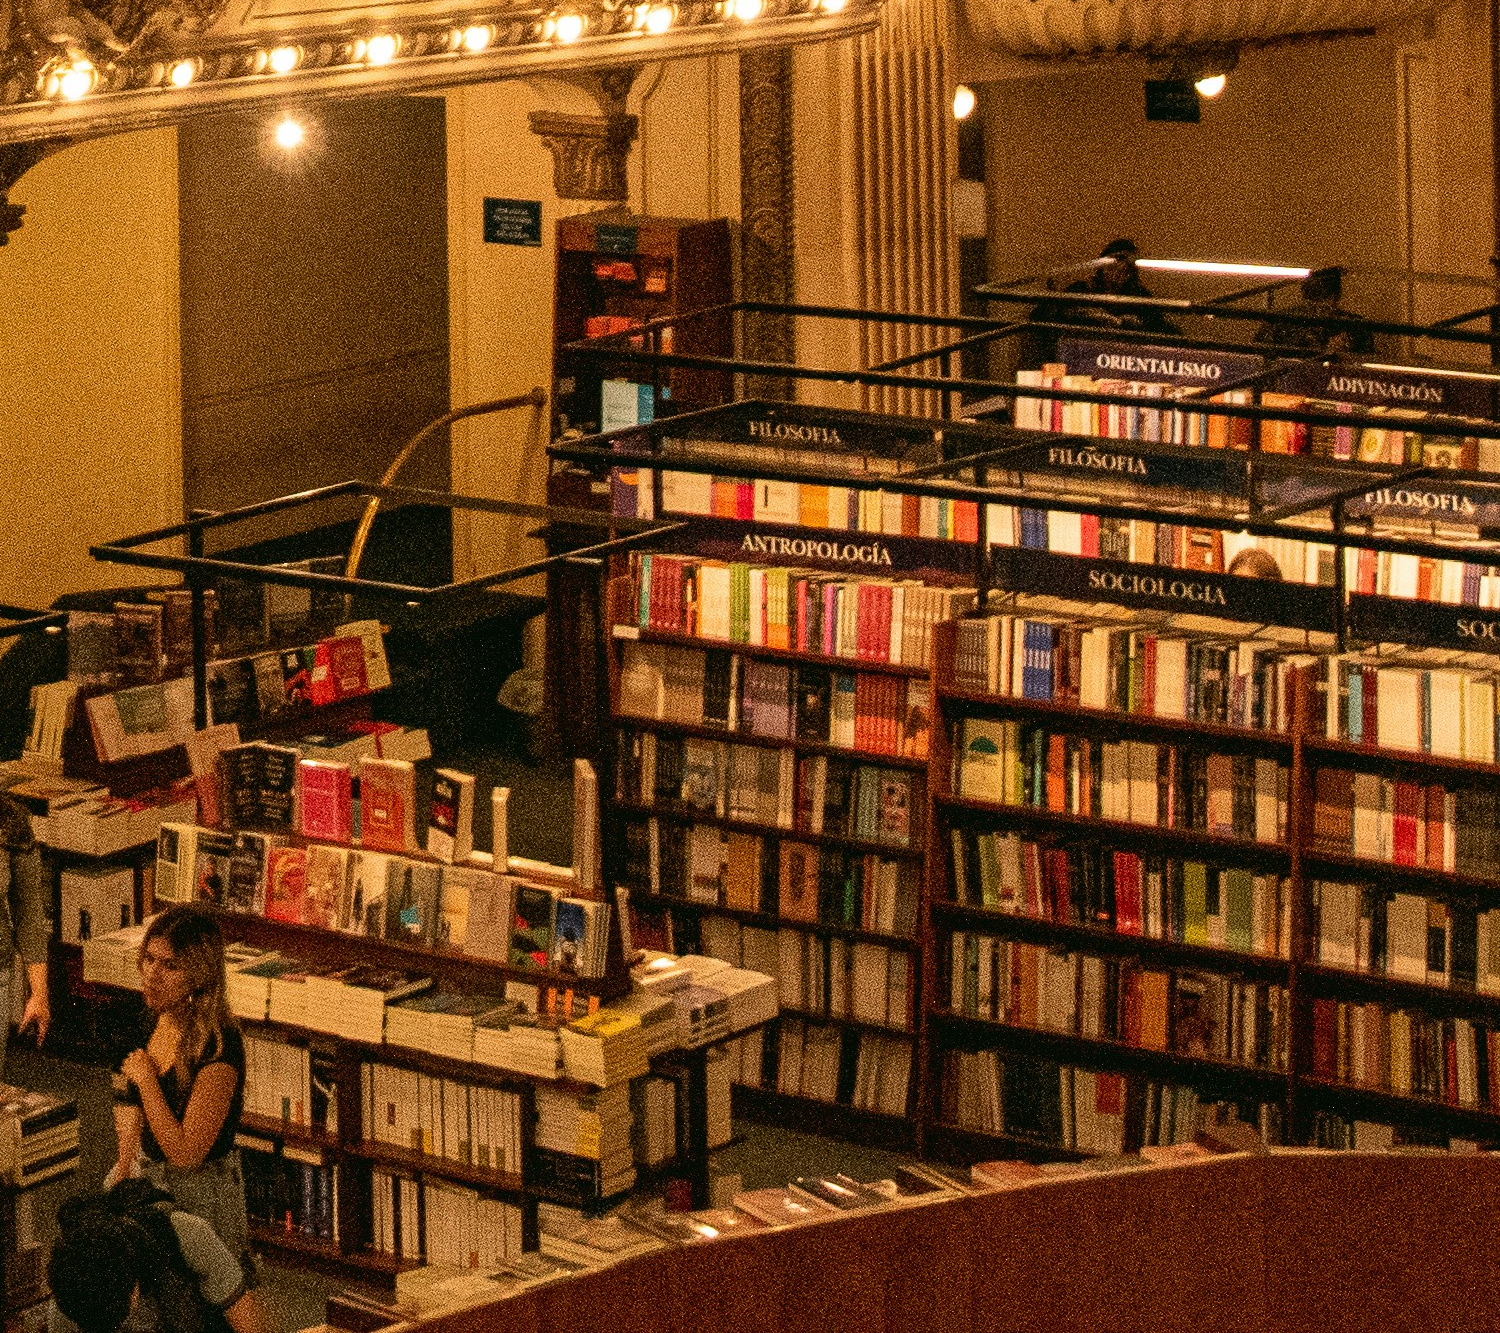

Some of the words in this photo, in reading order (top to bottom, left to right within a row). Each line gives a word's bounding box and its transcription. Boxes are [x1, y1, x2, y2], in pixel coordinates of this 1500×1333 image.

[1096, 353, 1222, 380] ORIENTALISMO
[1327, 376, 1444, 403] ADIVINACIÓN
[748, 419, 843, 445] FILOSOFIA
[1047, 447, 1148, 476] FILOSOFIA
[740, 533, 893, 567] ANTROPOLOGÍA
